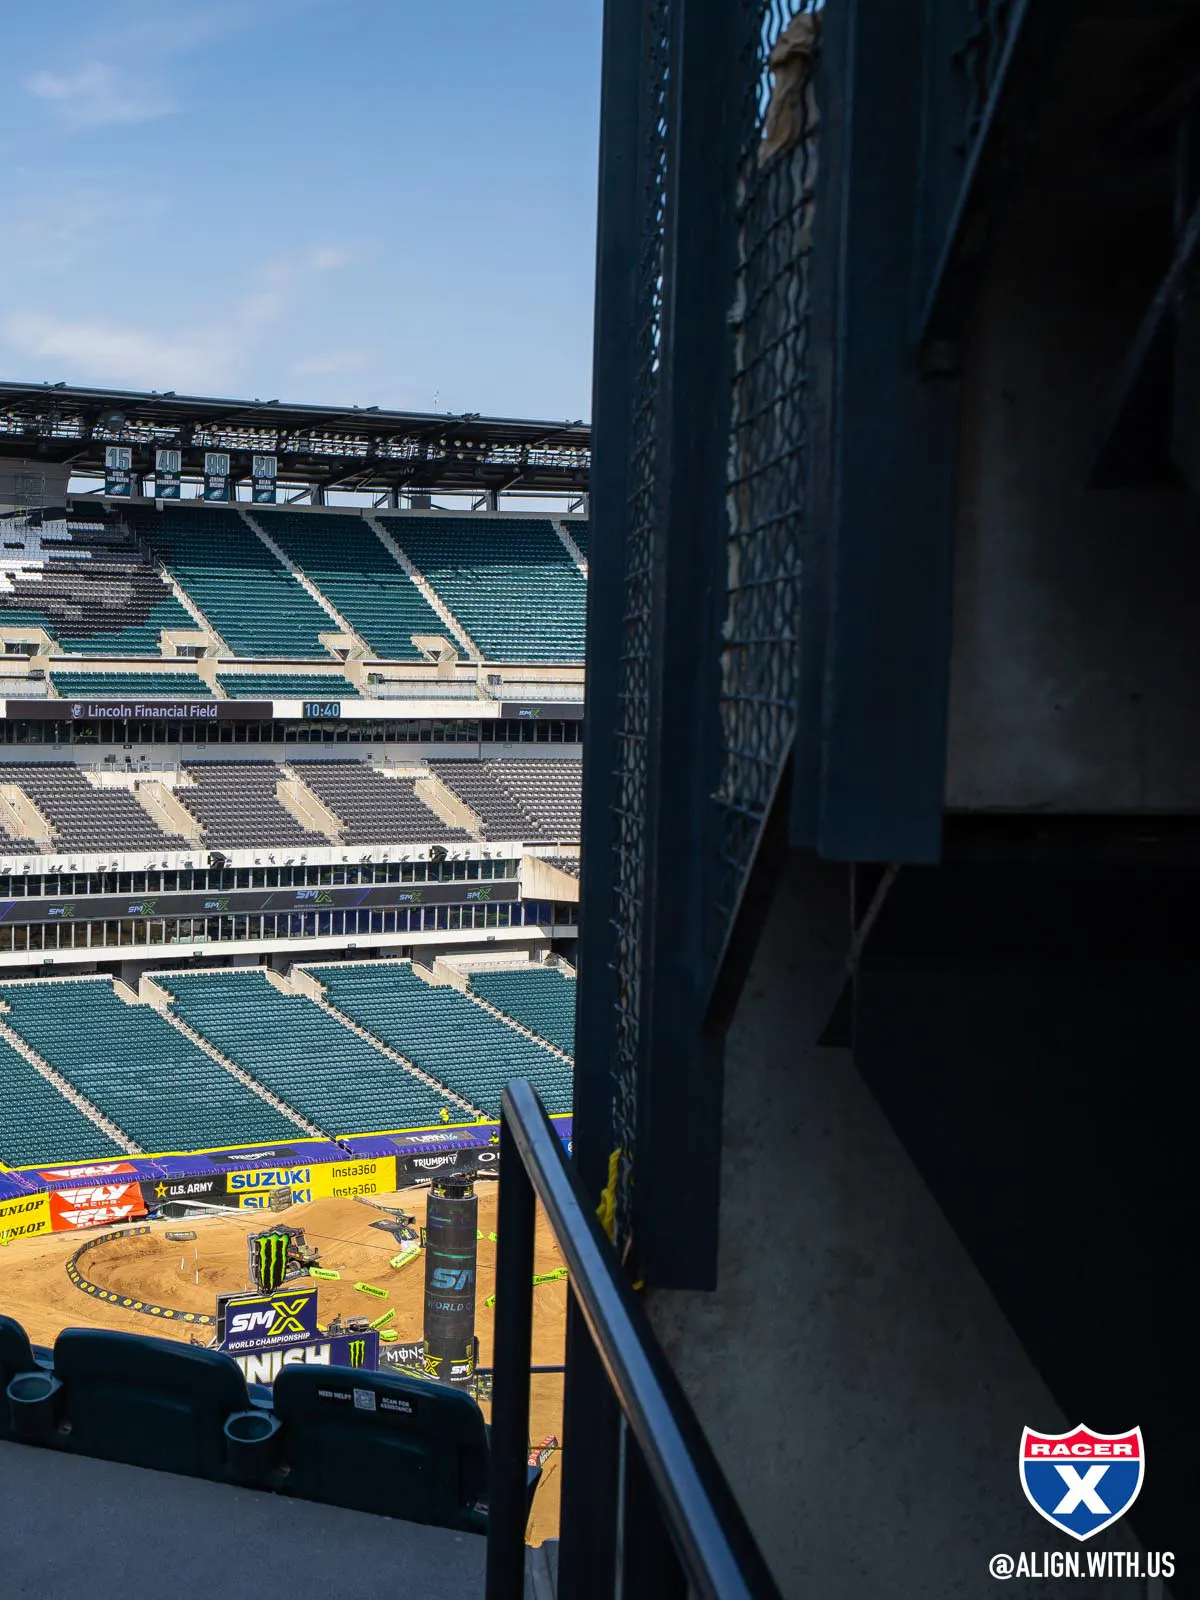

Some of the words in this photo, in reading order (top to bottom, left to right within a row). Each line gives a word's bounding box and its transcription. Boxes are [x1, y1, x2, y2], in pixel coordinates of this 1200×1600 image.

[108, 448, 130, 470] 15
[158, 451, 179, 472] 40
[207, 454, 228, 475] 99
[255, 457, 276, 478] 20
[88, 705, 131, 717] Lincoln
[135, 704, 187, 717] Financial
[191, 704, 218, 717] Field
[305, 703, 340, 717] 10:40
[295, 889, 333, 903] SMX
[466, 888, 492, 900] SMX
[48, 905, 75, 917] SMX
[127, 901, 156, 915] SMX
[203, 899, 230, 911] SMX
[413, 1155, 450, 1168] TRIUMPH
[231, 1168, 311, 1189] SUZUKI
[332, 1164, 376, 1178] Insta360
[55, 1183, 131, 1205] FLY
[170, 1185, 186, 1195] U.S.
[187, 1181, 213, 1194] ARMY
[333, 1183, 377, 1197] Insta360
[244, 1189, 312, 1208] SUKI
[58, 1204, 134, 1225] FLY
[229, 1298, 310, 1336] SMX
[228, 1340, 255, 1350] WORLD
[256, 1333, 310, 1348] CHAMPIONSHIP
[234, 1344, 331, 1385] INISH
